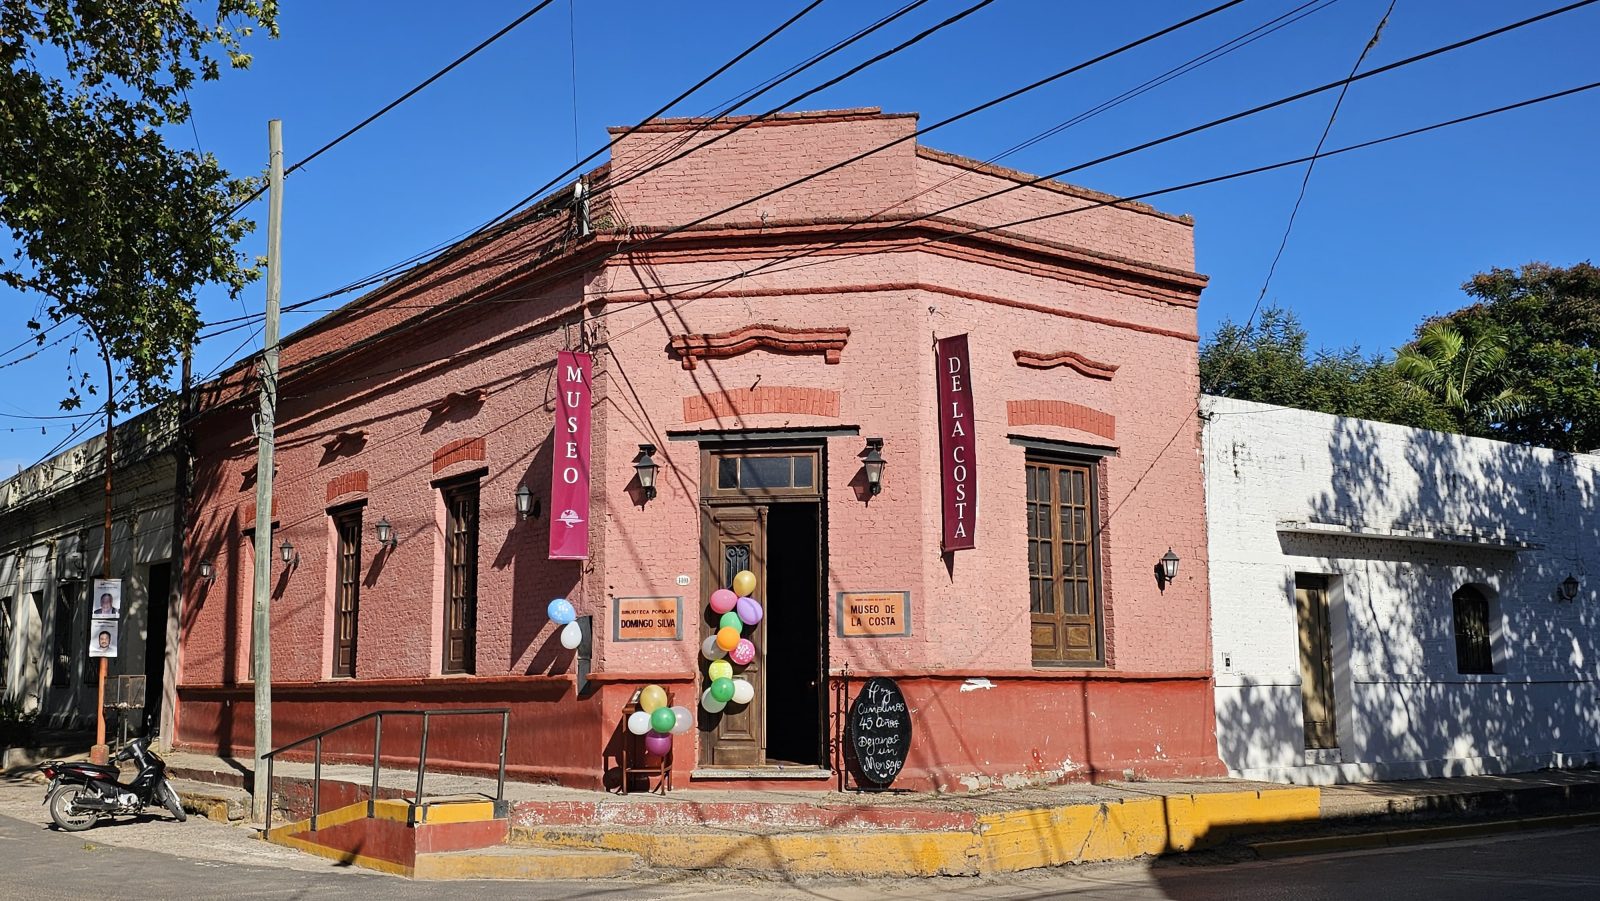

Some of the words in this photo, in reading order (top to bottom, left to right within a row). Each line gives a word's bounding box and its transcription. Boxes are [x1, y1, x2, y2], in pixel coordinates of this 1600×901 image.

[949, 356, 962, 392] DE
[563, 365, 583, 484] MUSEO
[951, 402, 965, 437] LA
[953, 446, 967, 539] COSTA
[850, 605, 879, 614] MUSEO
[885, 604, 895, 613] DE
[621, 619, 654, 629] DOMINGO
[657, 618, 676, 628] SILVA
[851, 617, 862, 626] LA
[868, 617, 896, 626] COSTA
[859, 717, 873, 730] 45
[877, 748, 897, 756] un
